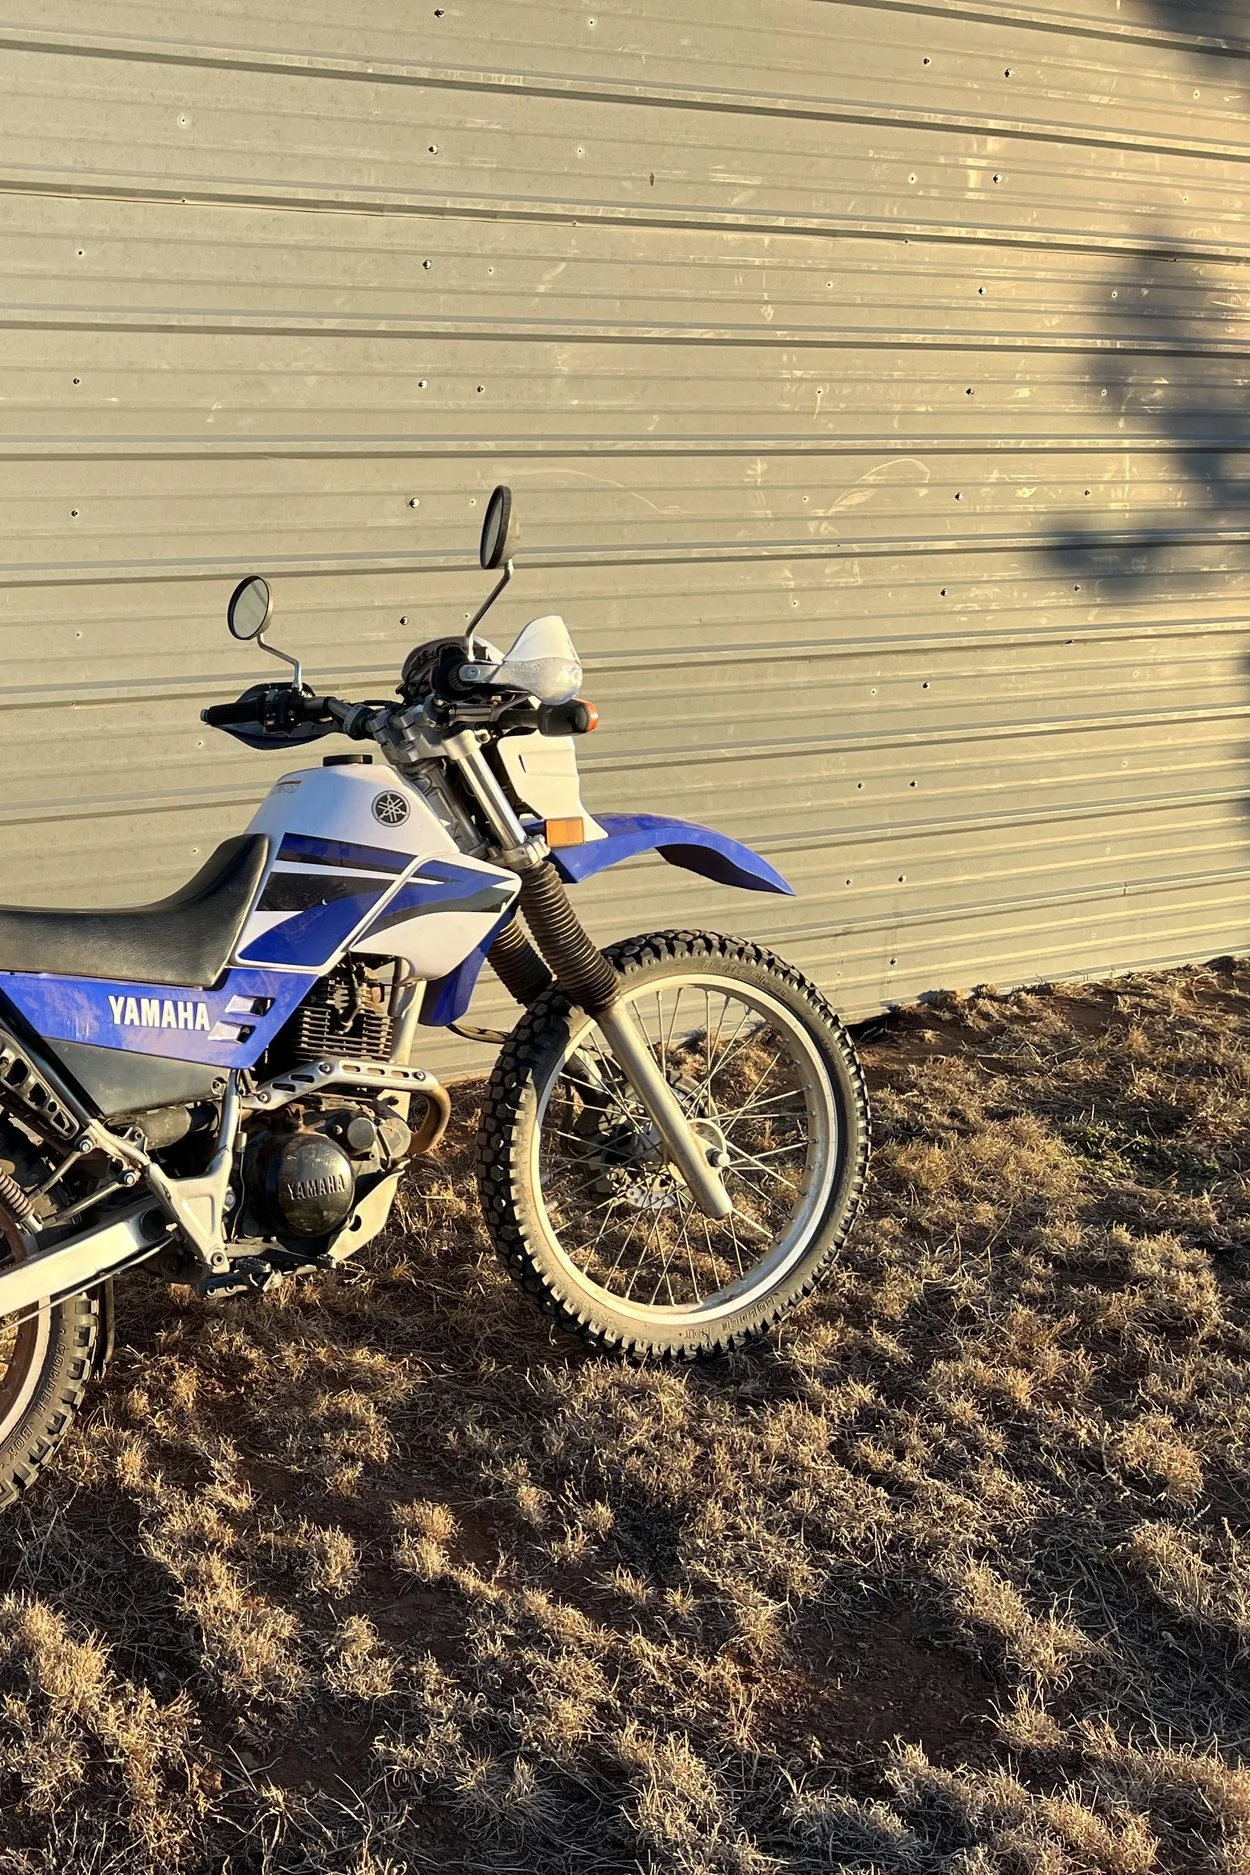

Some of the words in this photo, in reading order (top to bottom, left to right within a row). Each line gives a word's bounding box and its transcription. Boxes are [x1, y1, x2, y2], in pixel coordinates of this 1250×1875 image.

[107, 995, 210, 1031] YAMAHA
[287, 1174, 345, 1200] YAMAHA
[34, 1342, 66, 1417] GOLDEN
[6, 1425, 34, 1461] BOY
